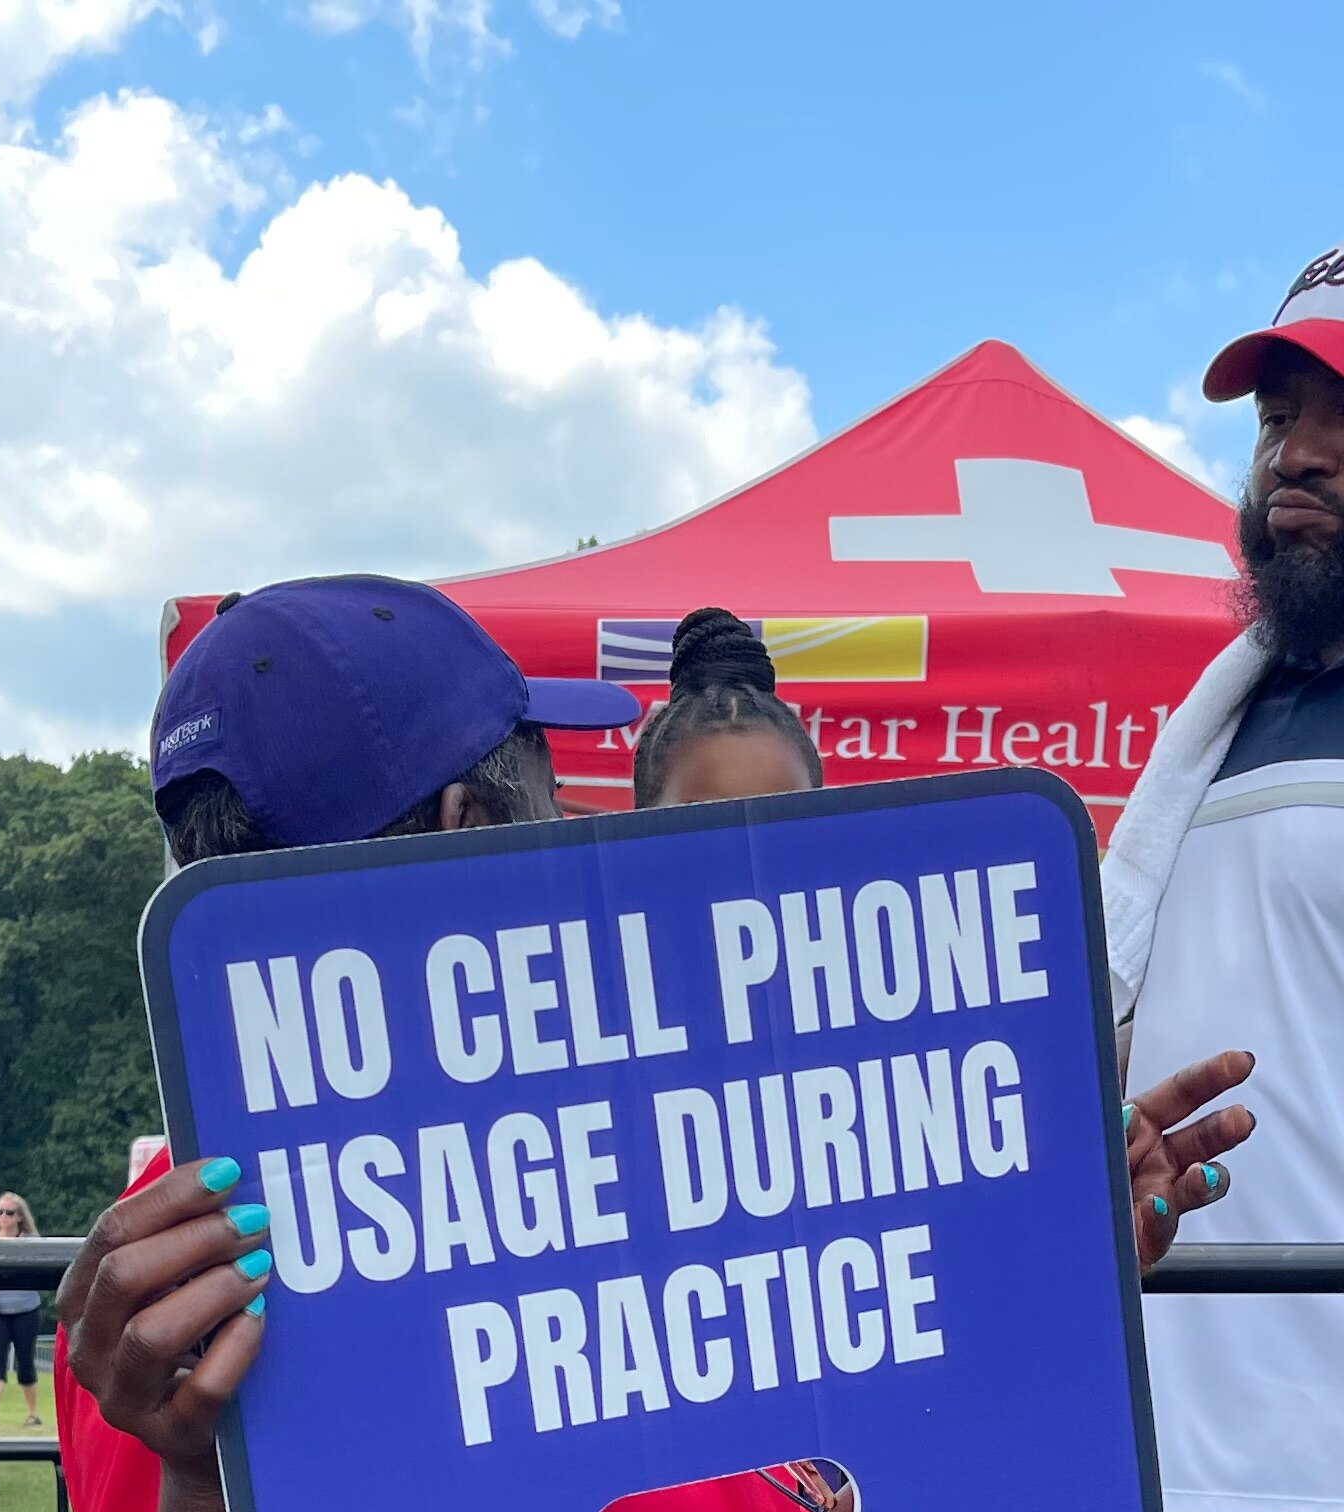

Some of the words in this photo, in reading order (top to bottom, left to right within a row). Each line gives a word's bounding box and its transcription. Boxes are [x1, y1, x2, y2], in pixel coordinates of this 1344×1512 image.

[226, 947, 393, 1114] NO
[424, 912, 687, 1085] CELL
[710, 861, 1049, 1045] PHONE
[258, 1101, 629, 1294] USAGE
[653, 1040, 1030, 1232] DURING
[445, 1224, 945, 1447] PRACTICE
